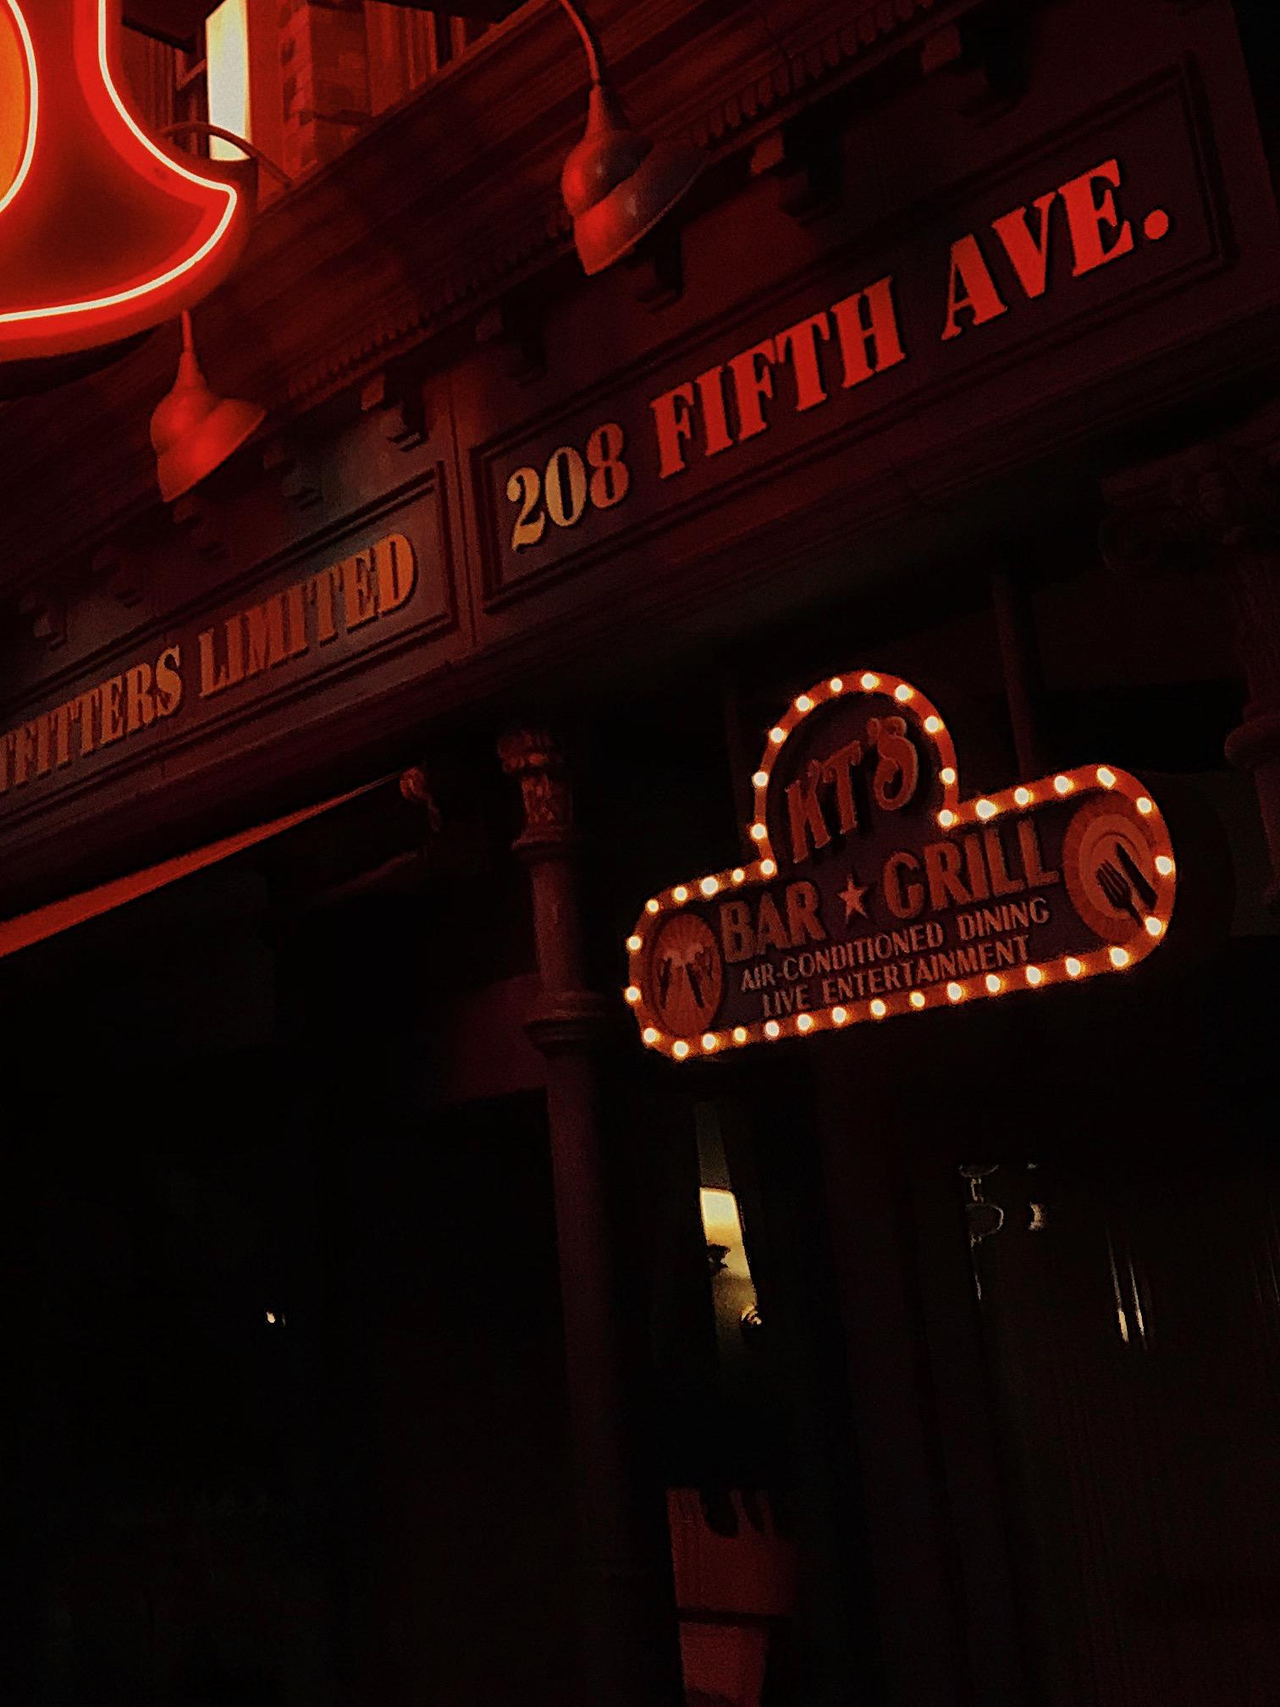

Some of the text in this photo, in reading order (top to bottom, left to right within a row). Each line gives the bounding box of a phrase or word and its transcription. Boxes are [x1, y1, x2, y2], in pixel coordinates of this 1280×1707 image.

[507, 158, 1171, 551] 208 FIFTH AVE.
[196, 532, 418, 698] LIMITED
[720, 816, 1061, 964] BAR GRILL
[740, 896, 1050, 992] AIR-CONDITIONED DINING
[761, 934, 1031, 1018] LIVE ENTERTAINMENT
